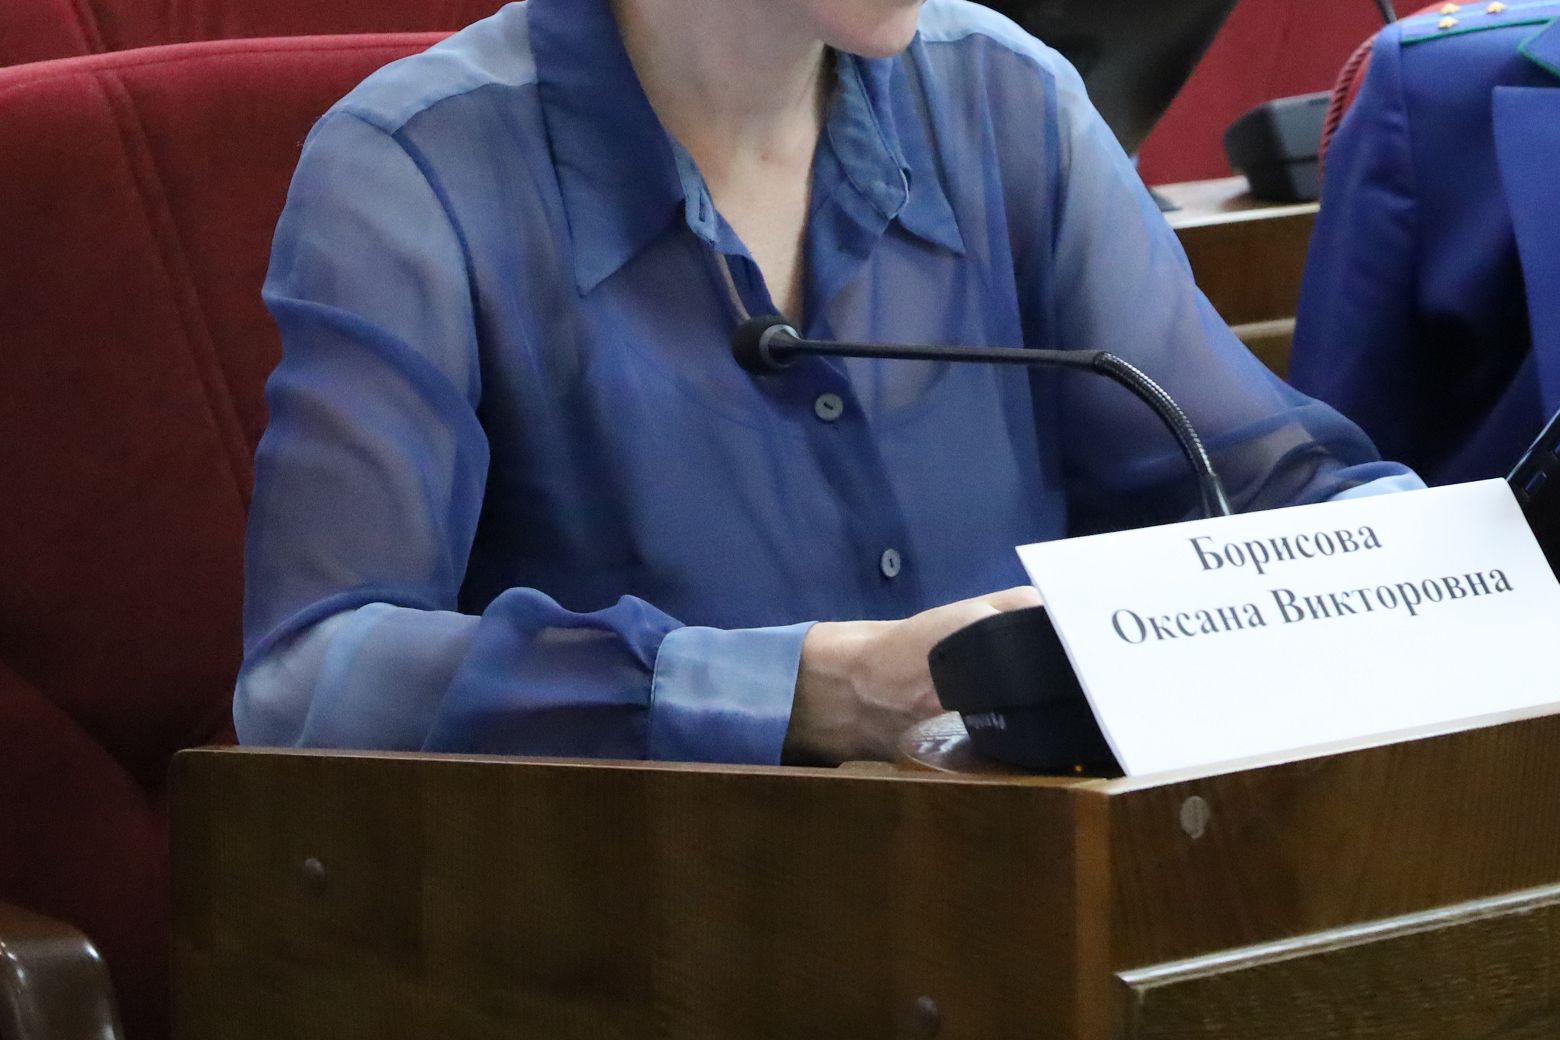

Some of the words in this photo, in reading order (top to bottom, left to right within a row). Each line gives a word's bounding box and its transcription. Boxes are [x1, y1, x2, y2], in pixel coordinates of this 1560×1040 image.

[1188, 525, 1383, 575] Борисова
[1110, 603, 1267, 644] Оксана
[1270, 567, 1514, 624] Викторовна
